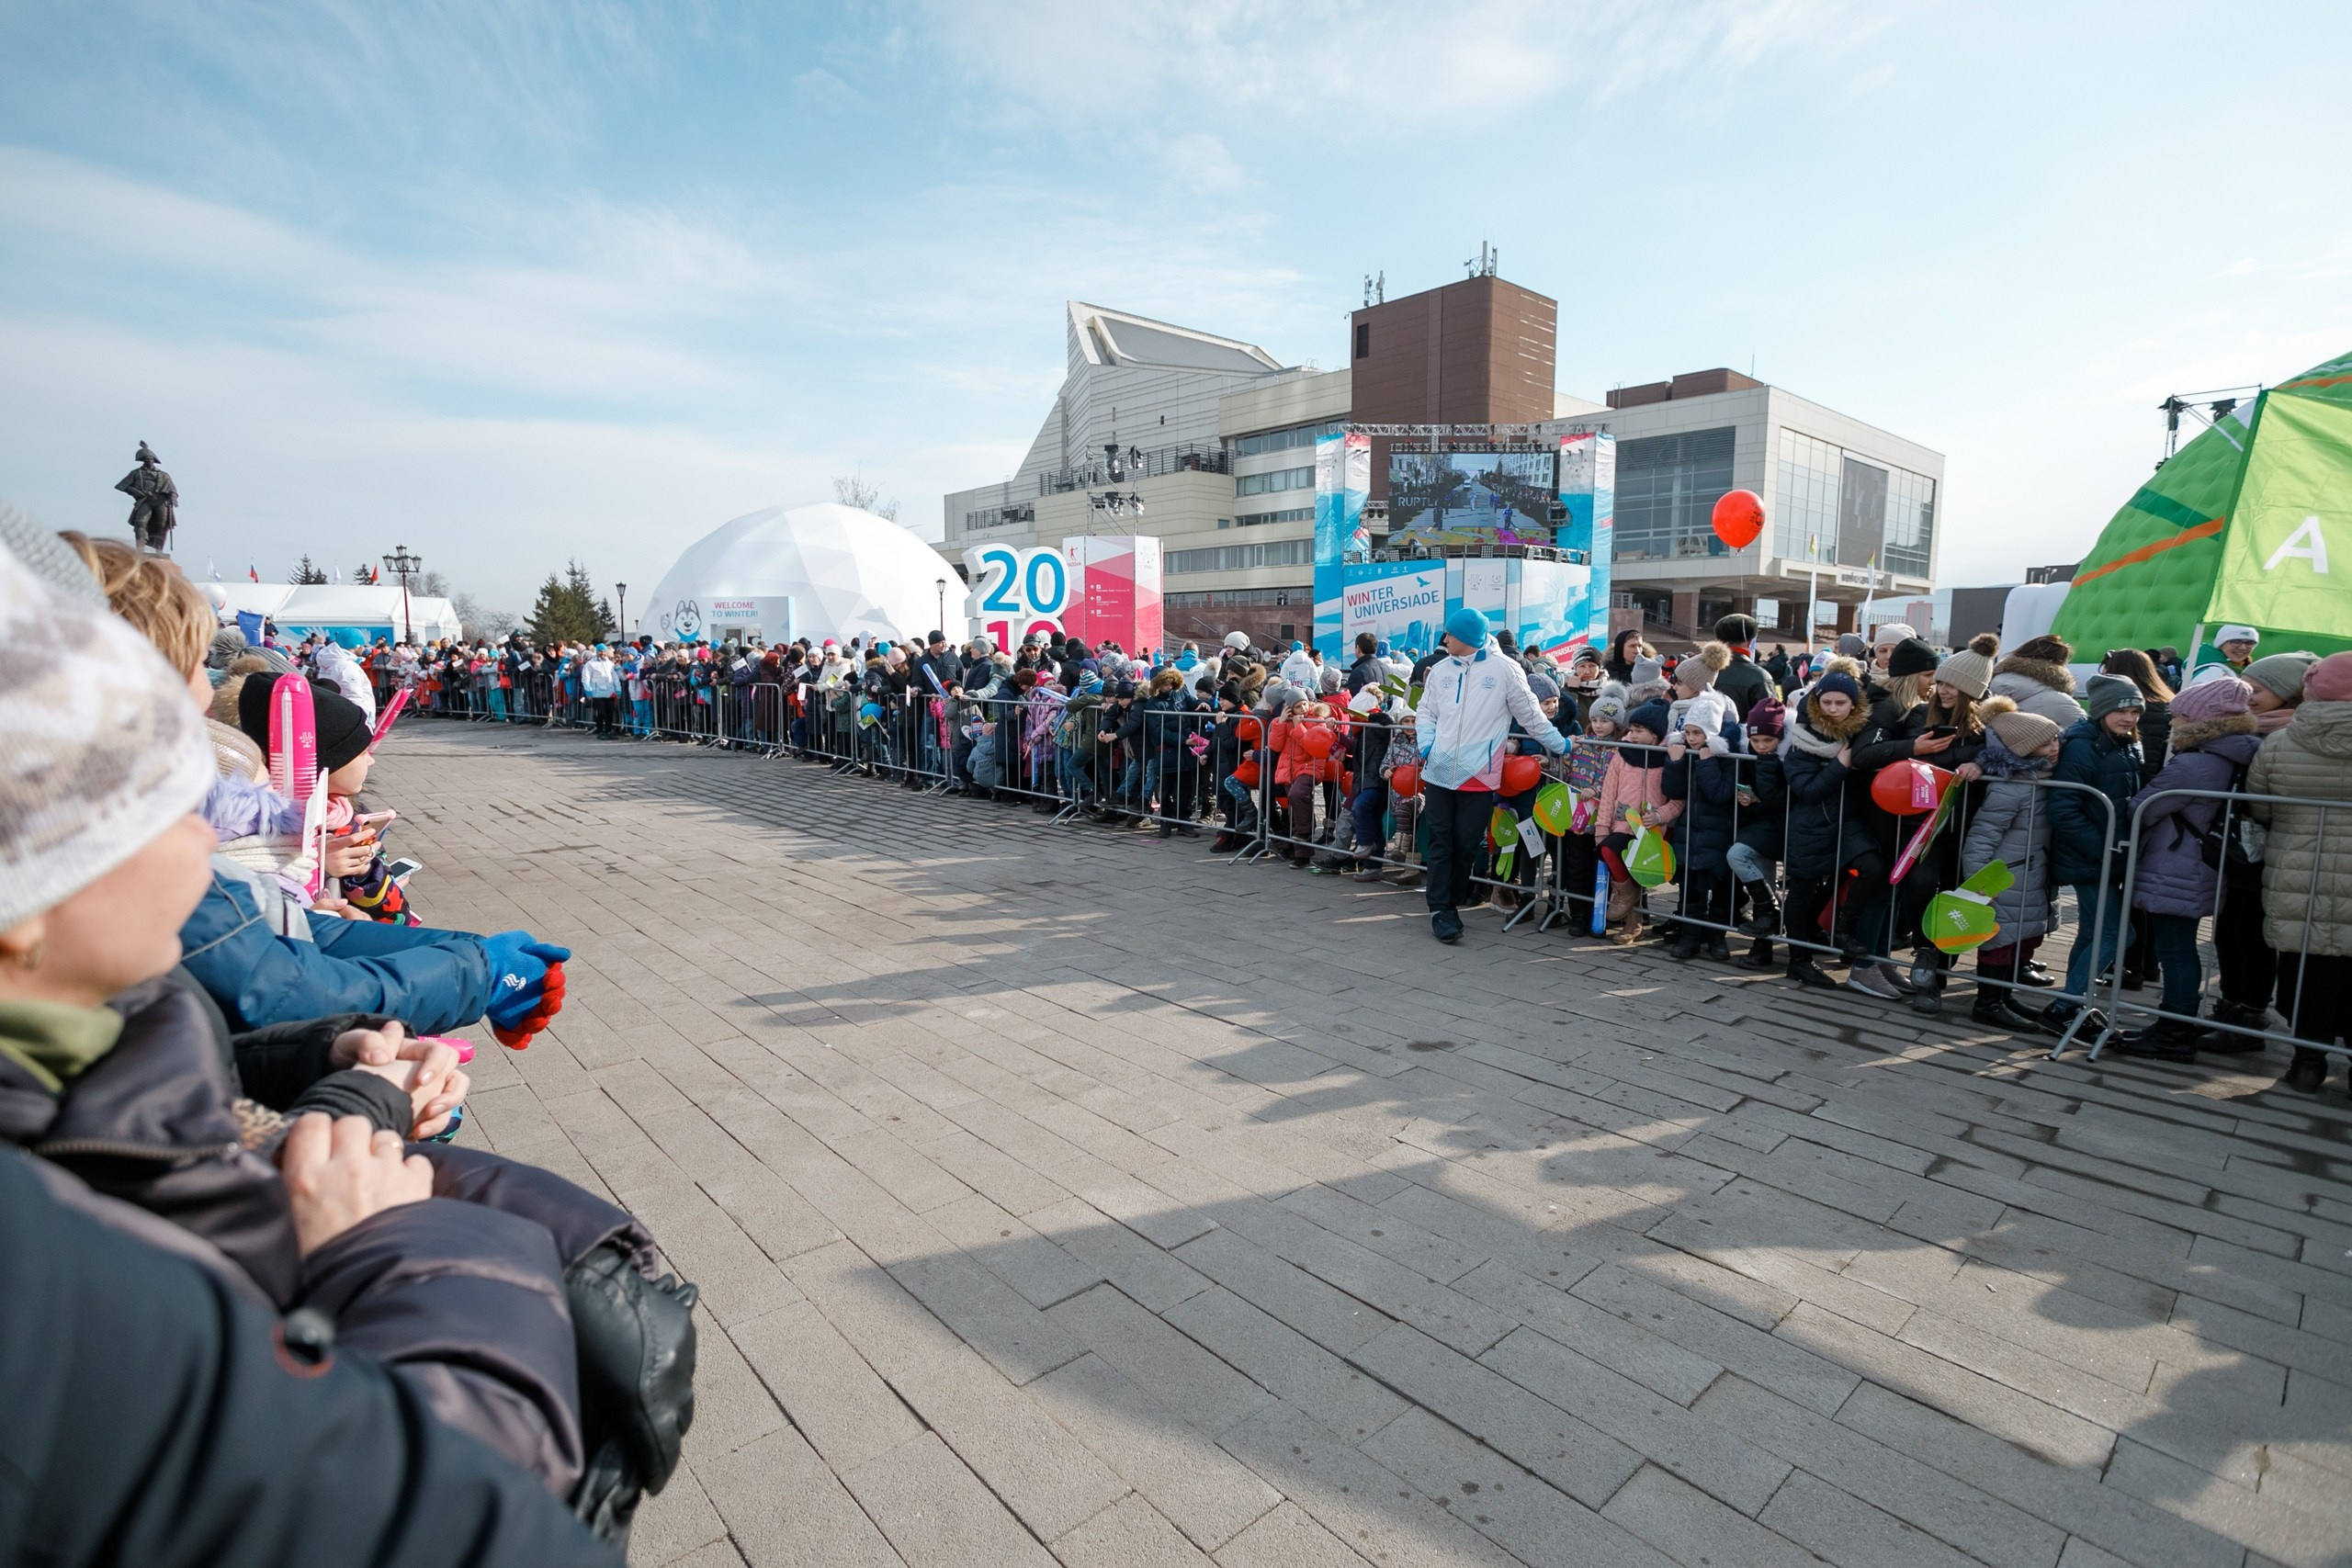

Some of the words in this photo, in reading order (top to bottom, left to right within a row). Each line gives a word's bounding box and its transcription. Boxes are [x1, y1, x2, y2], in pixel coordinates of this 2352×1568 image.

[2263, 514, 2329, 574] A
[980, 548, 1067, 615] 20
[714, 601, 755, 609] WELCOME
[1346, 585, 1395, 607] WINTER
[1354, 590, 1441, 619] UNIVERSIADE
[711, 610, 723, 618] TO
[724, 610, 759, 618] WINTER!
